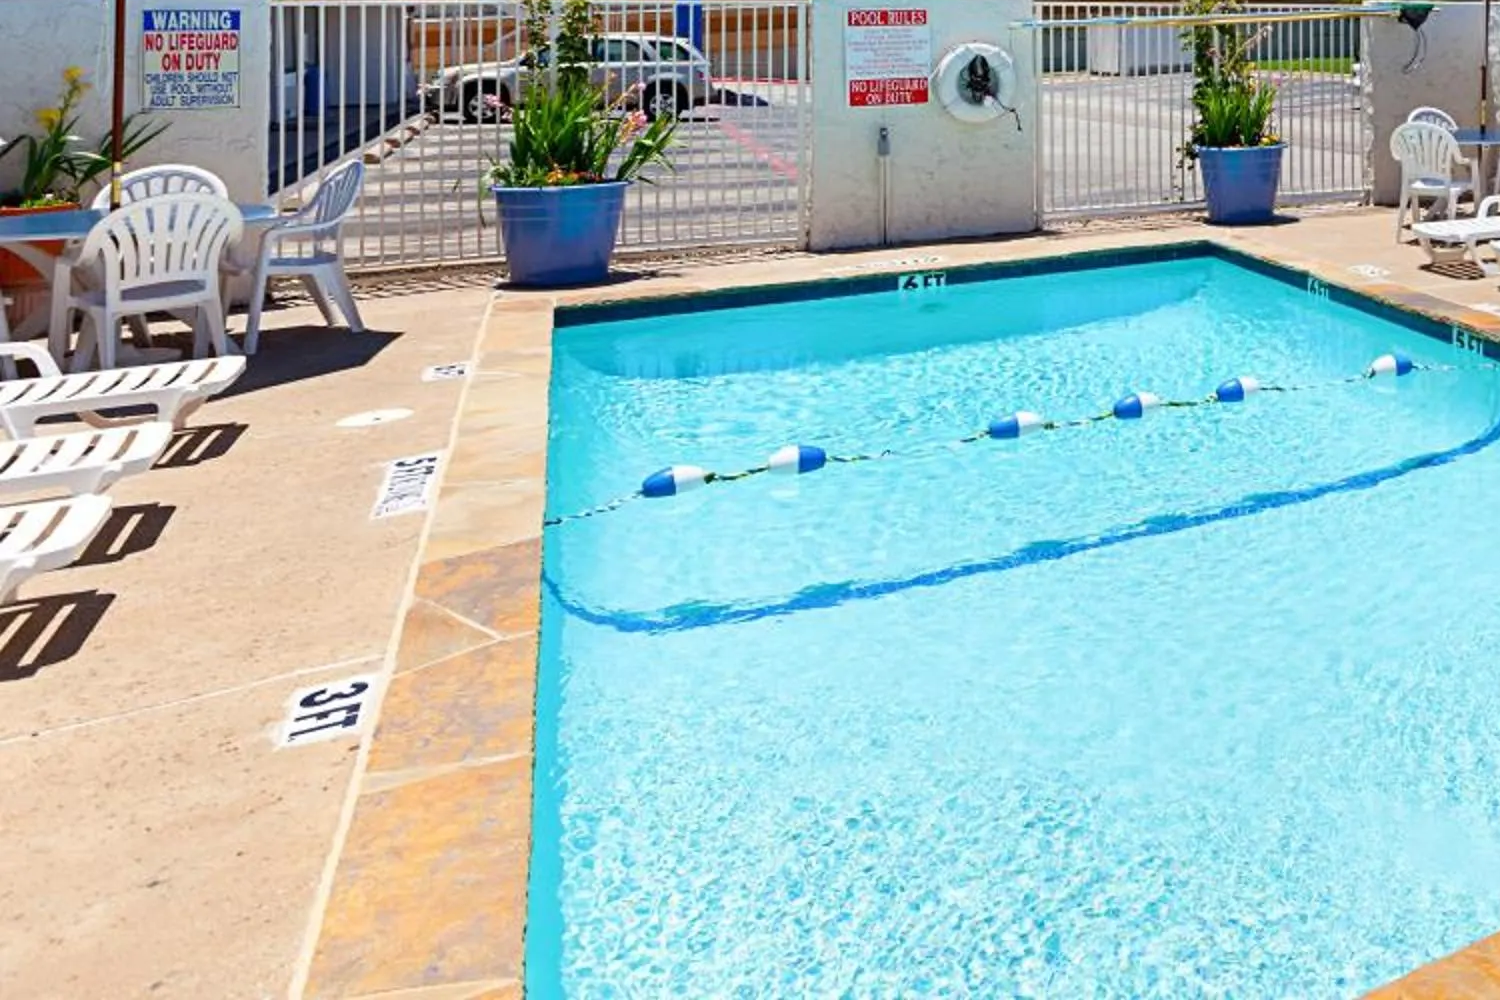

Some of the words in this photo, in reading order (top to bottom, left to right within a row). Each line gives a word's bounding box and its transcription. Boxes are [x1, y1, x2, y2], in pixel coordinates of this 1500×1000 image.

[153, 11, 232, 29] WARNING
[851, 11, 885, 25] POOL
[887, 10, 925, 25] RULES
[145, 33, 164, 51] NO
[169, 32, 238, 50] LIFEGUARD
[161, 53, 180, 72] ON
[185, 52, 221, 71] DUTY
[187, 72, 218, 82] SHOULD
[221, 71, 239, 81] NOT
[852, 81, 867, 93] NO
[869, 79, 928, 92] LIFEGUARD
[866, 93, 882, 104] ON
[885, 92, 913, 103] DUTY
[902, 275, 919, 290] 6
[923, 272, 945, 289] FT
[1456, 330, 1465, 349] 5
[299, 682, 369, 708] 3
